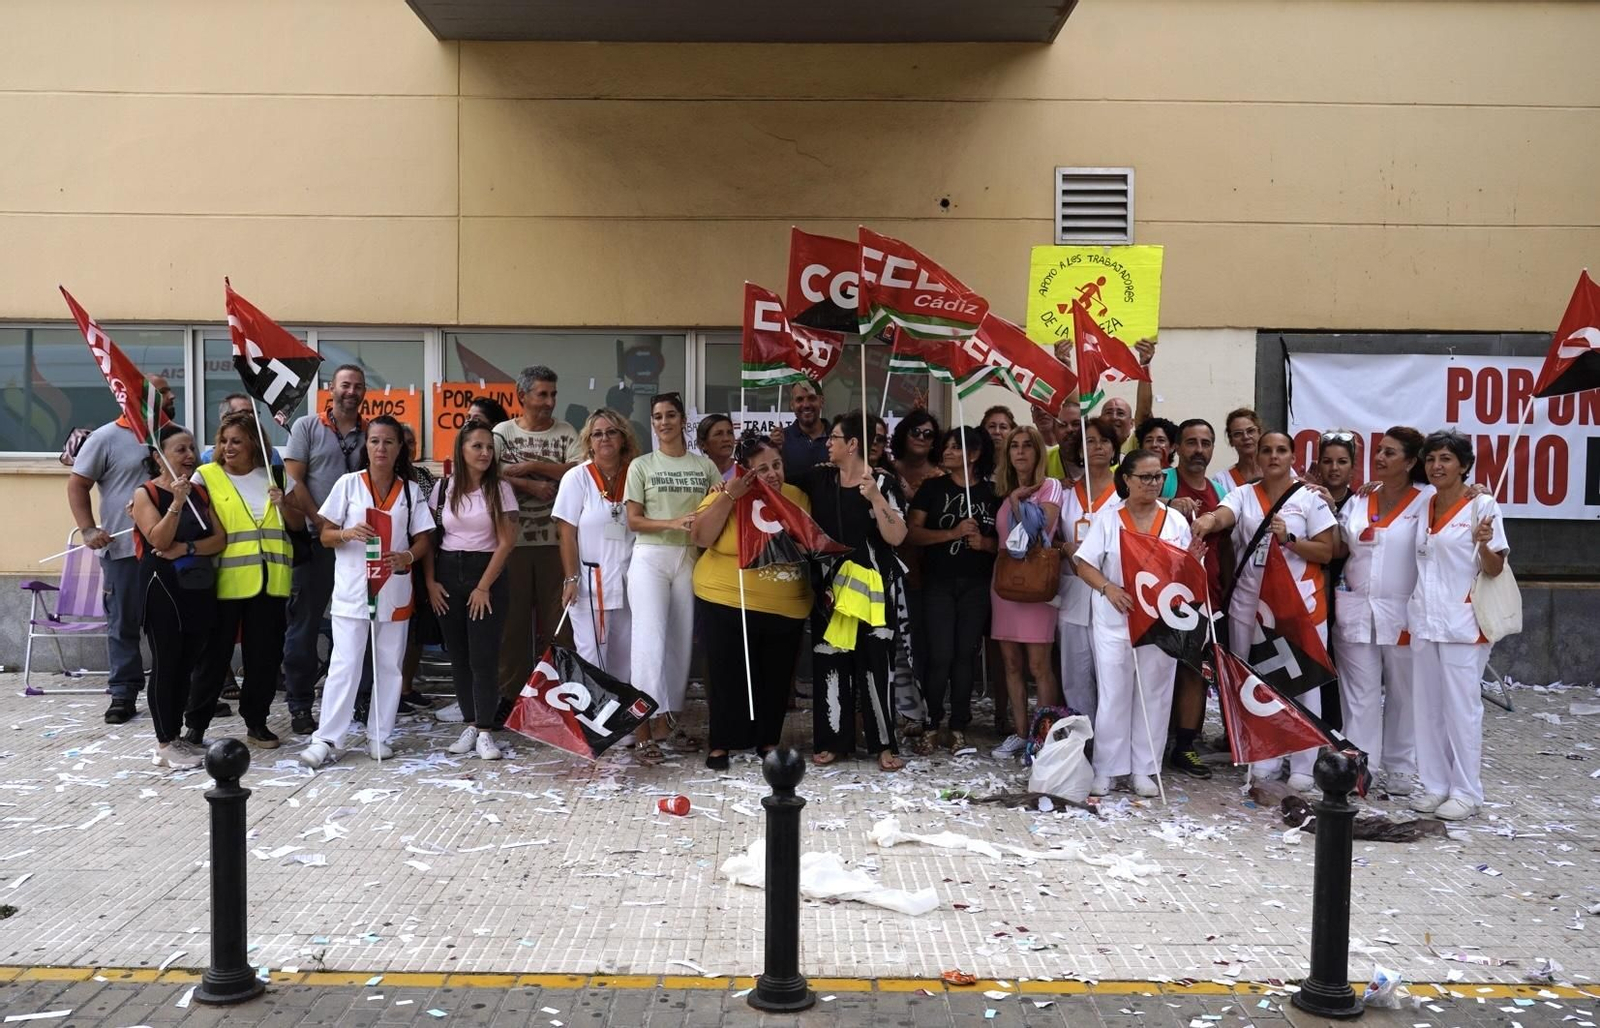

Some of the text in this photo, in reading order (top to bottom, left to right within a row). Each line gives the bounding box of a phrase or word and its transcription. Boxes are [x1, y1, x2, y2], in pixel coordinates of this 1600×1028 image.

[800, 263, 860, 309] CG
[1039, 268, 1058, 298] APOYO
[1059, 261, 1067, 270] A
[914, 294, 980, 316] Cádiz
[1040, 311, 1069, 339] DE LA
[443, 390, 474, 409] POR
[1446, 366, 1534, 425] POR
[651, 478, 675, 486] UNDER
[675, 478, 689, 486] THE
[1135, 570, 1211, 636] CG
